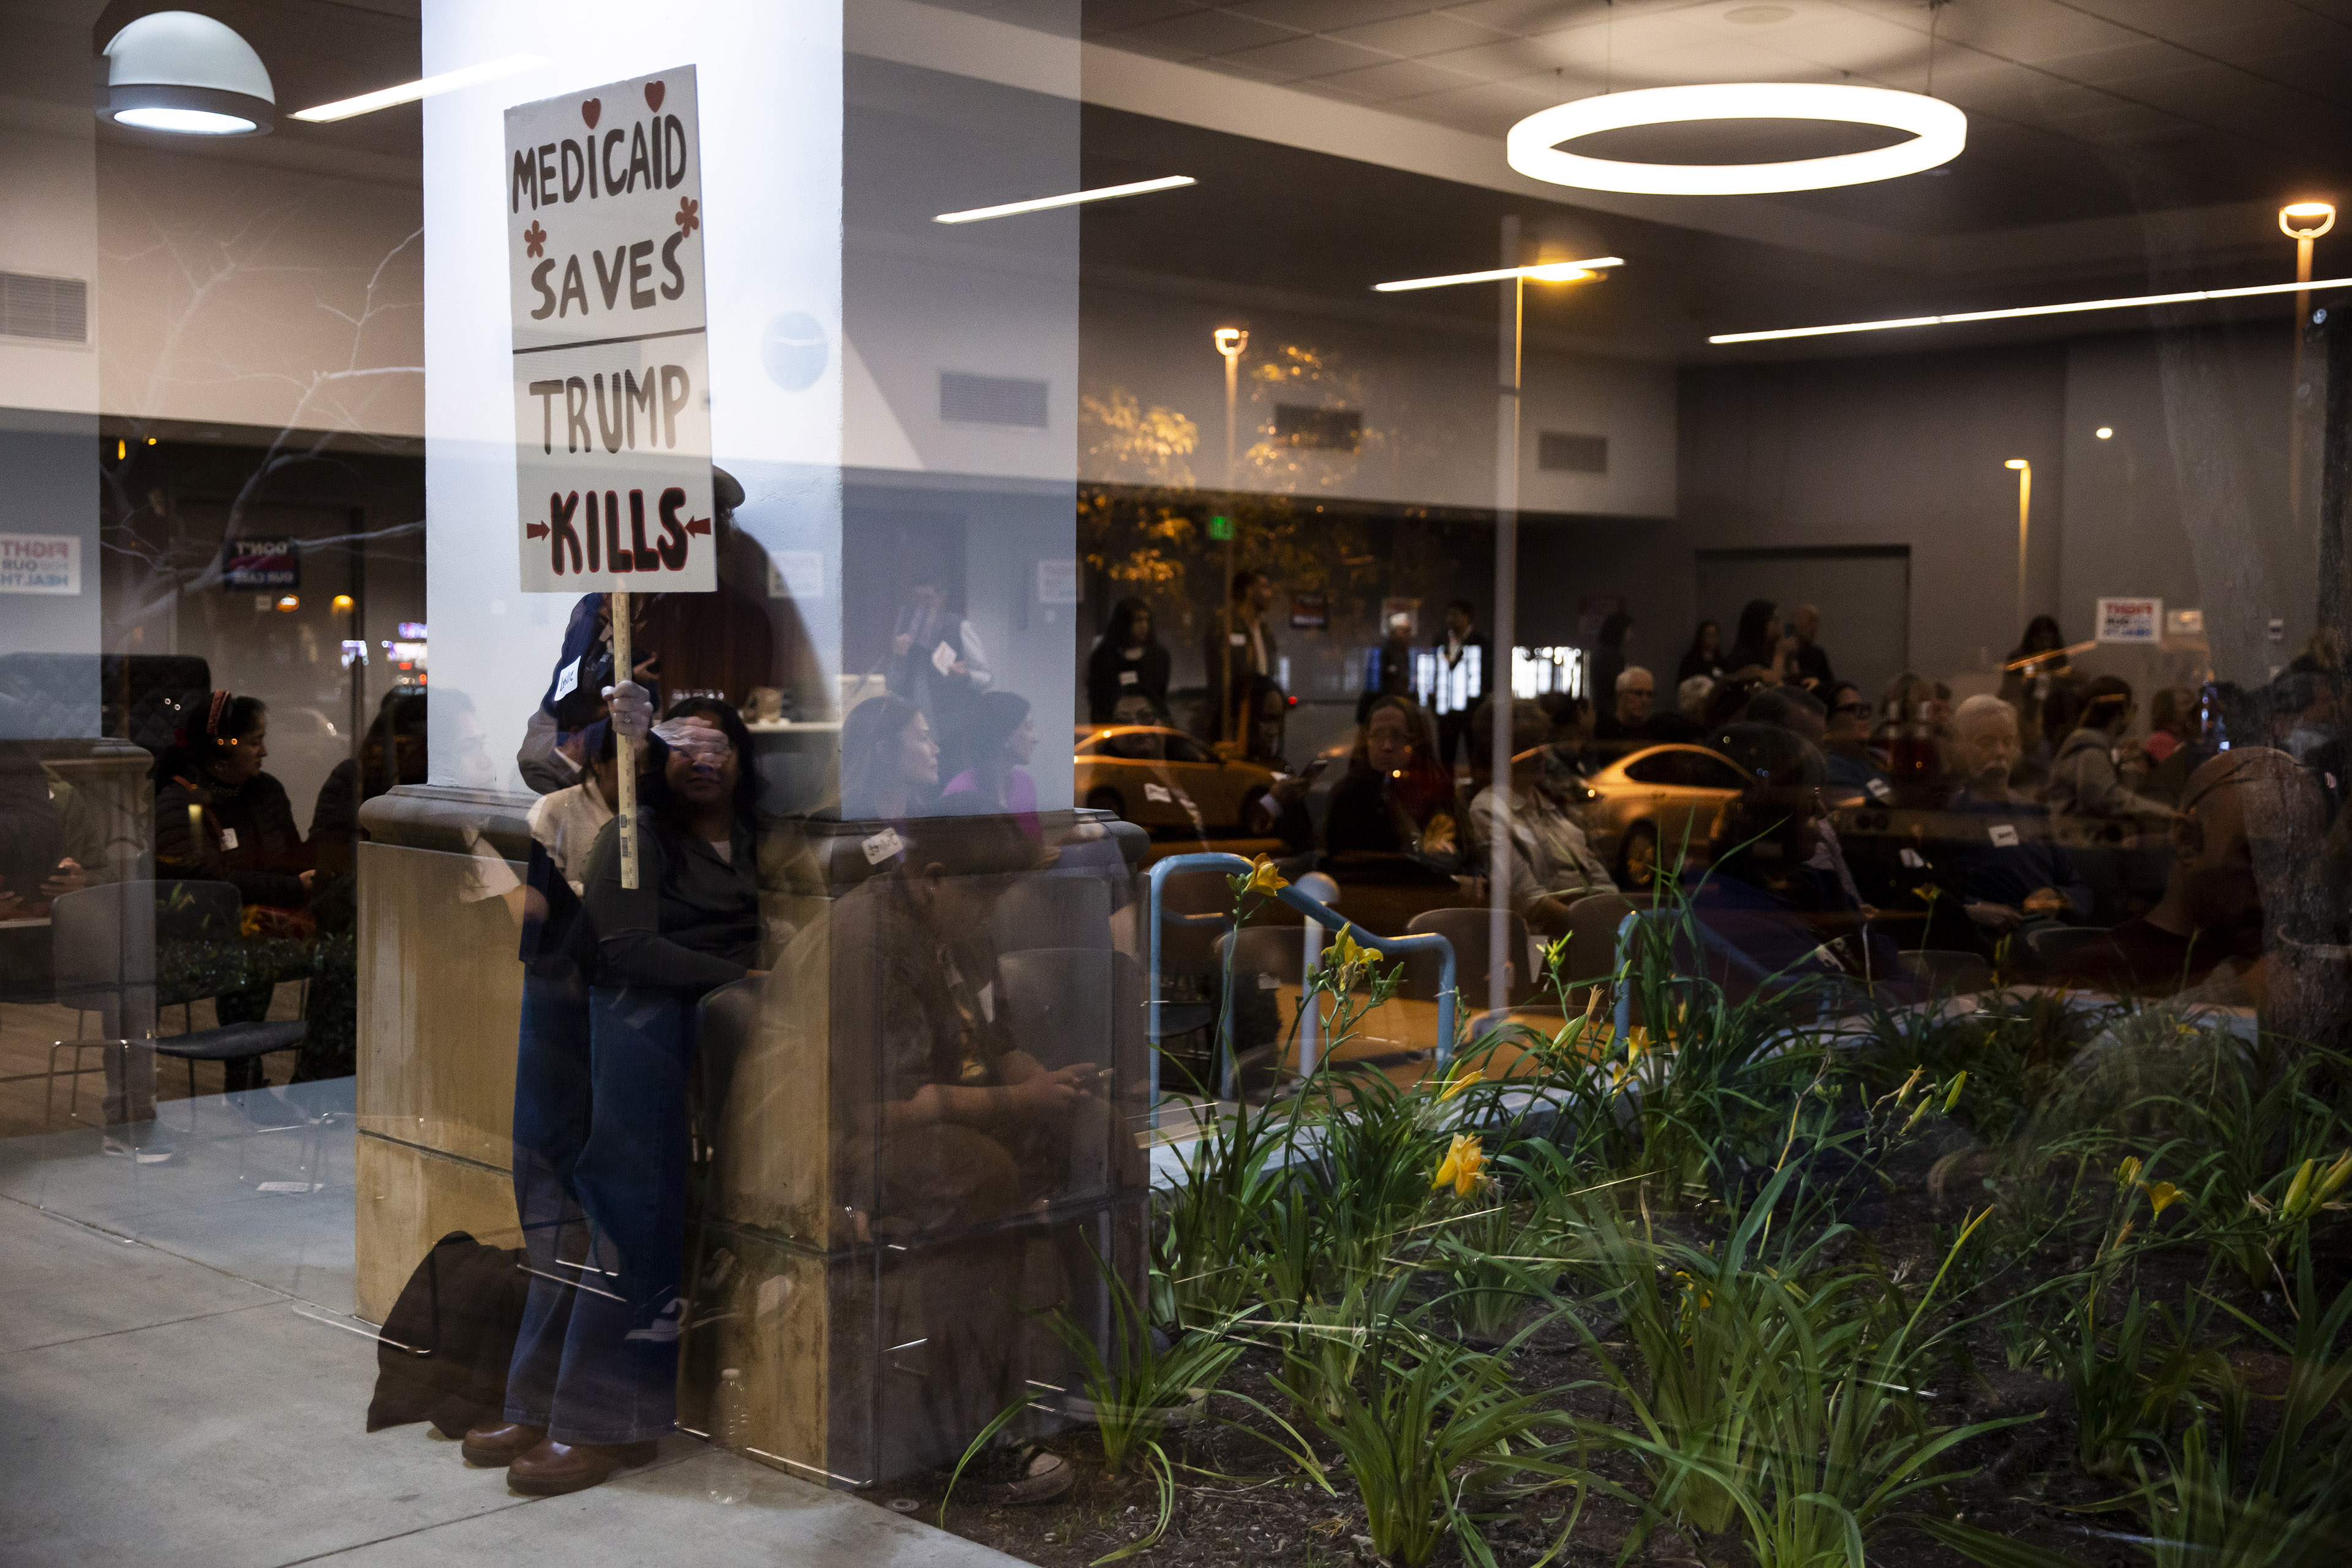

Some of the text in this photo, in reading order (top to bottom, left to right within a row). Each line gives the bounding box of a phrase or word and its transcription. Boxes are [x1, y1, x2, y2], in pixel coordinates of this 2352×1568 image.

[512, 113, 687, 214] MEDICAID
[530, 231, 685, 320] SAVES
[529, 364, 691, 456] TRUMP
[550, 487, 688, 576] KILLS
